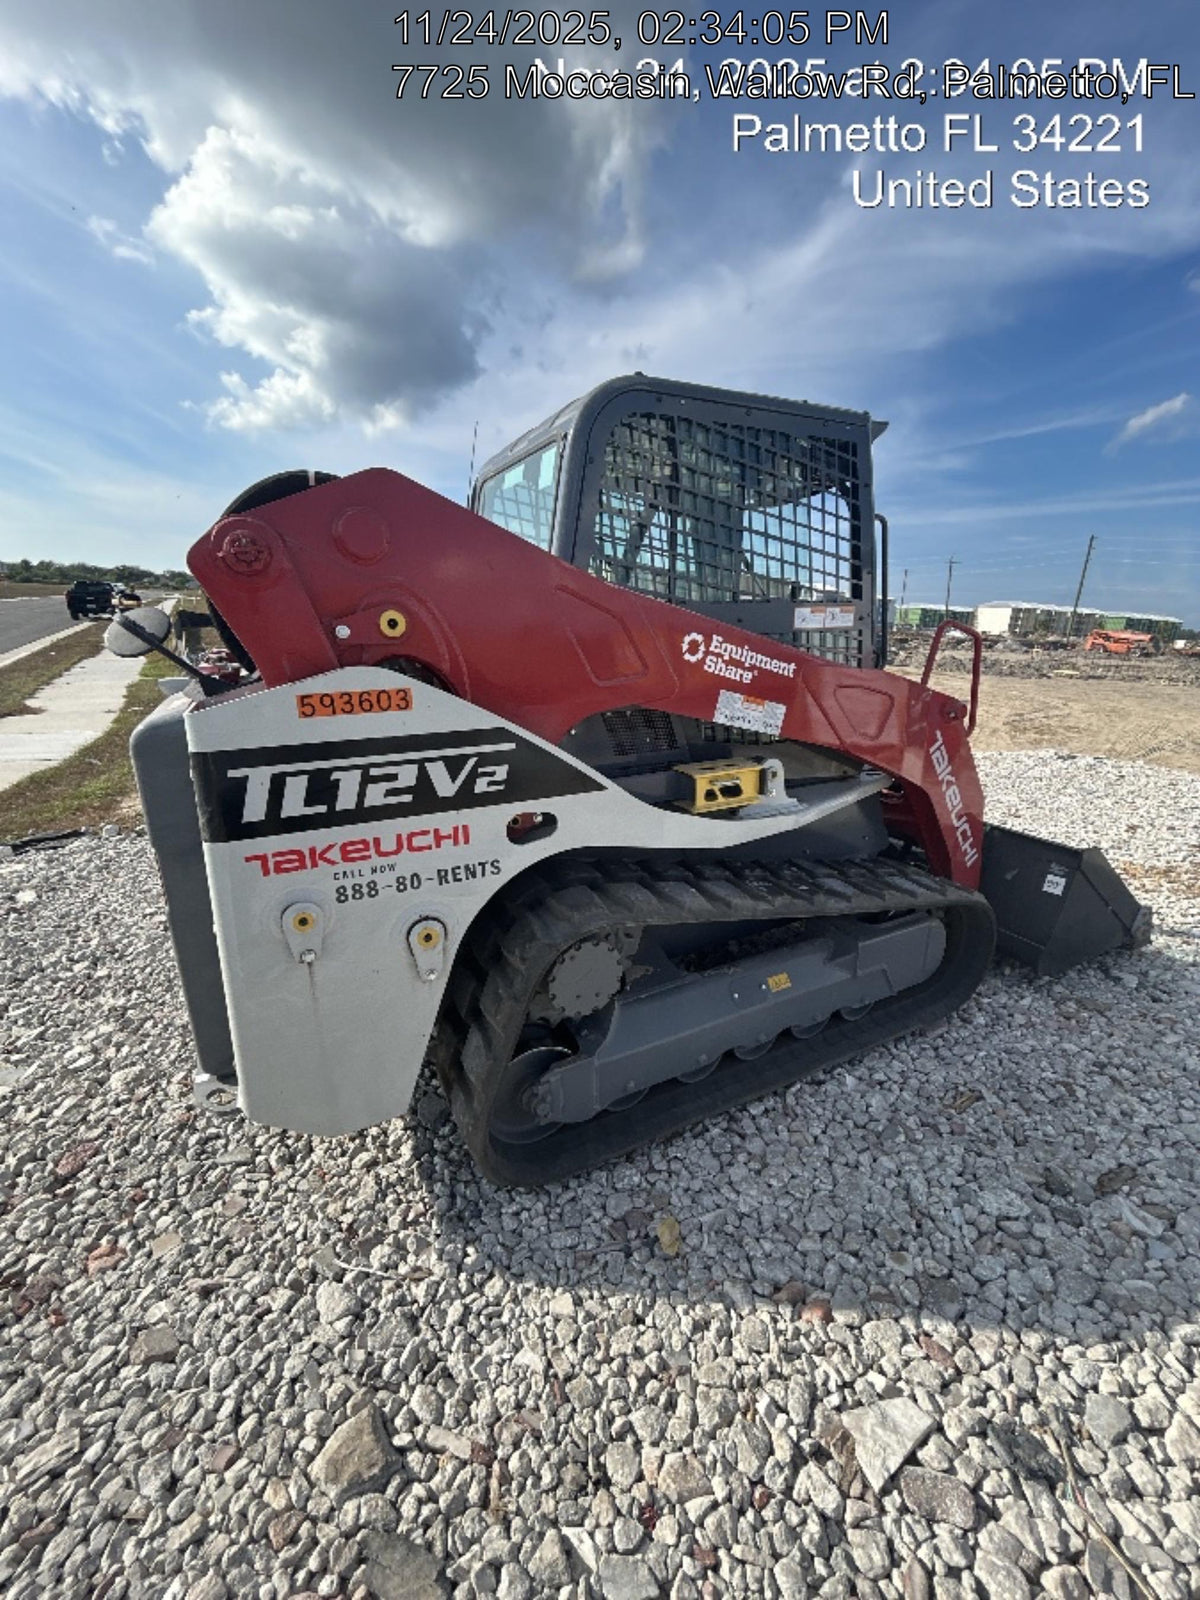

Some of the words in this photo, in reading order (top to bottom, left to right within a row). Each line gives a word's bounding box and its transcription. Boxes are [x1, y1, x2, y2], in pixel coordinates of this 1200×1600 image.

[709, 634, 797, 678] Equipment
[299, 690, 411, 718] 593603
[333, 870, 366, 881] CALL
[370, 863, 398, 875] NOW
[335, 860, 502, 904] 888-80-RENTS
